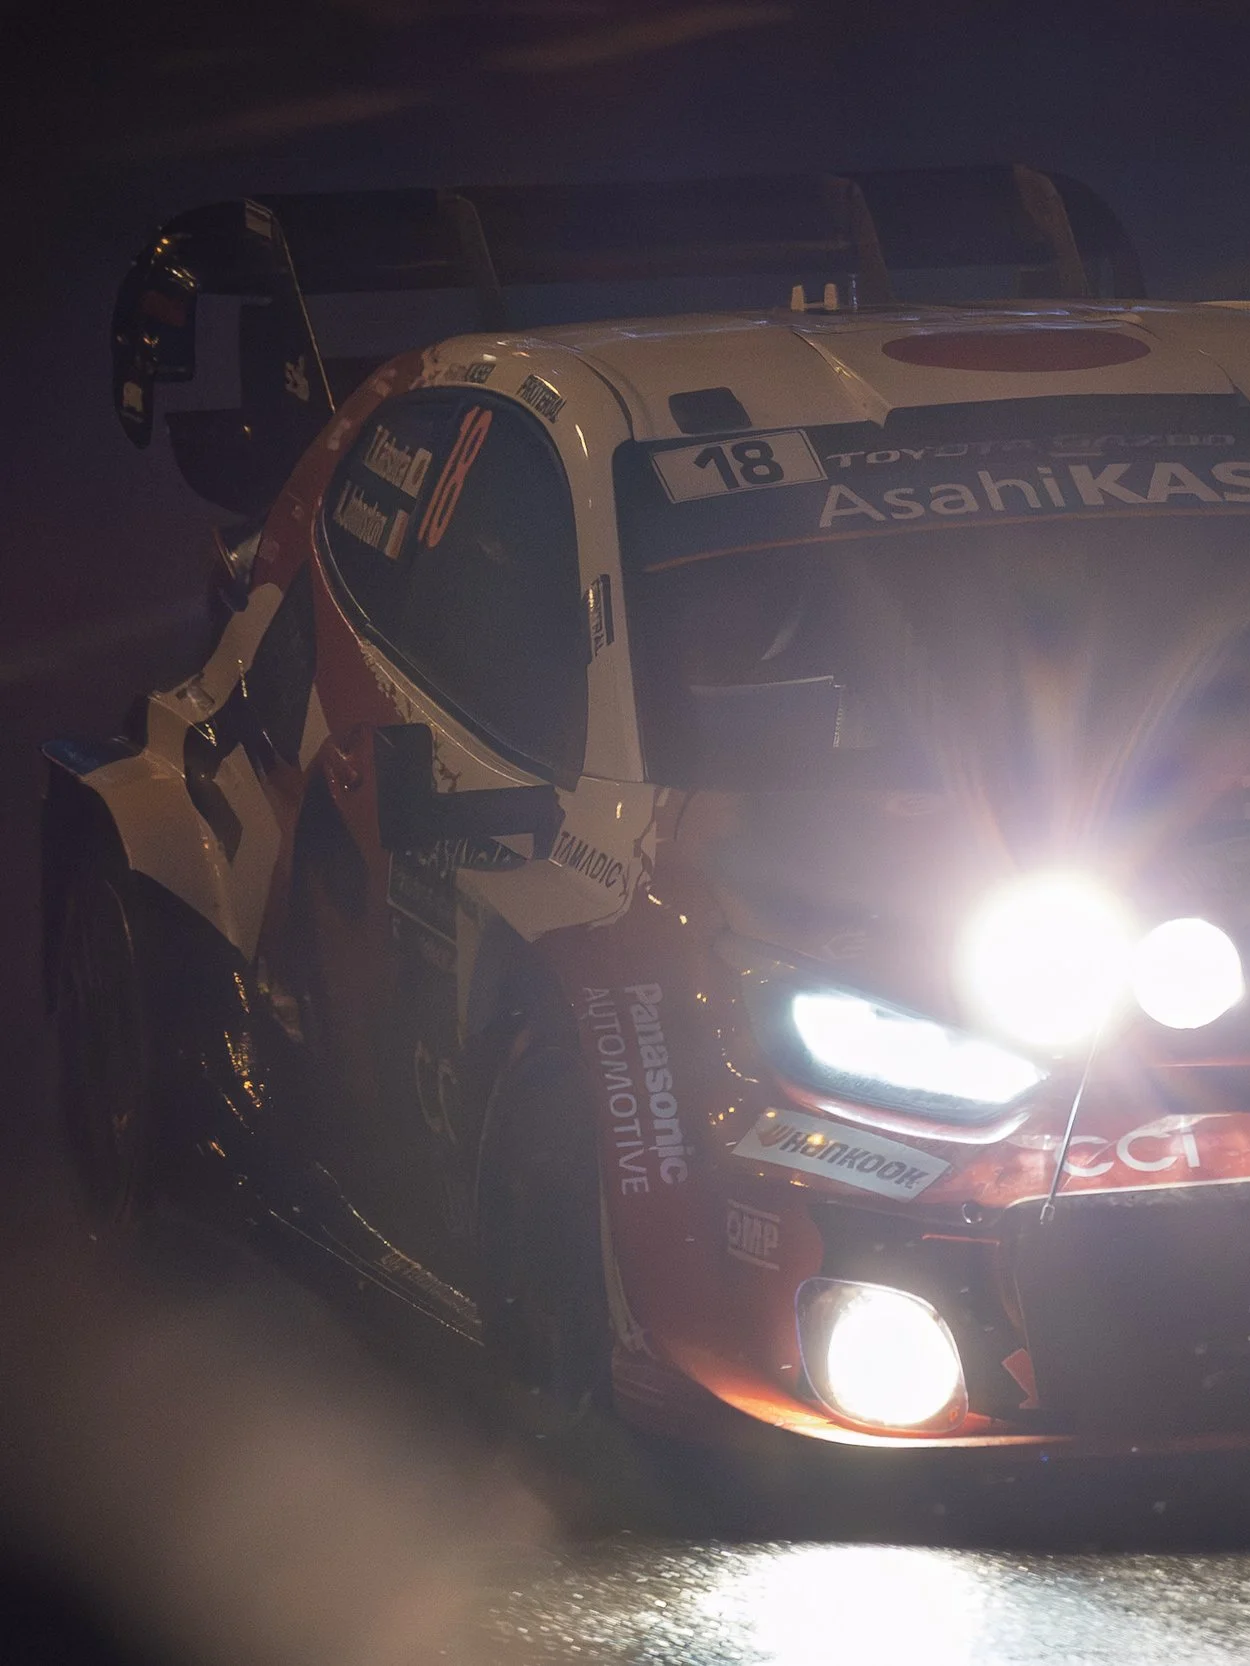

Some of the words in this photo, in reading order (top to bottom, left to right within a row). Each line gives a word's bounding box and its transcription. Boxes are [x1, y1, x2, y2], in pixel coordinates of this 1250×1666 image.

[693, 440, 785, 491] 18
[582, 987, 650, 1196] AUTOMOTIVE
[624, 982, 695, 1185] Panasonic
[727, 1208, 779, 1256] OMP
